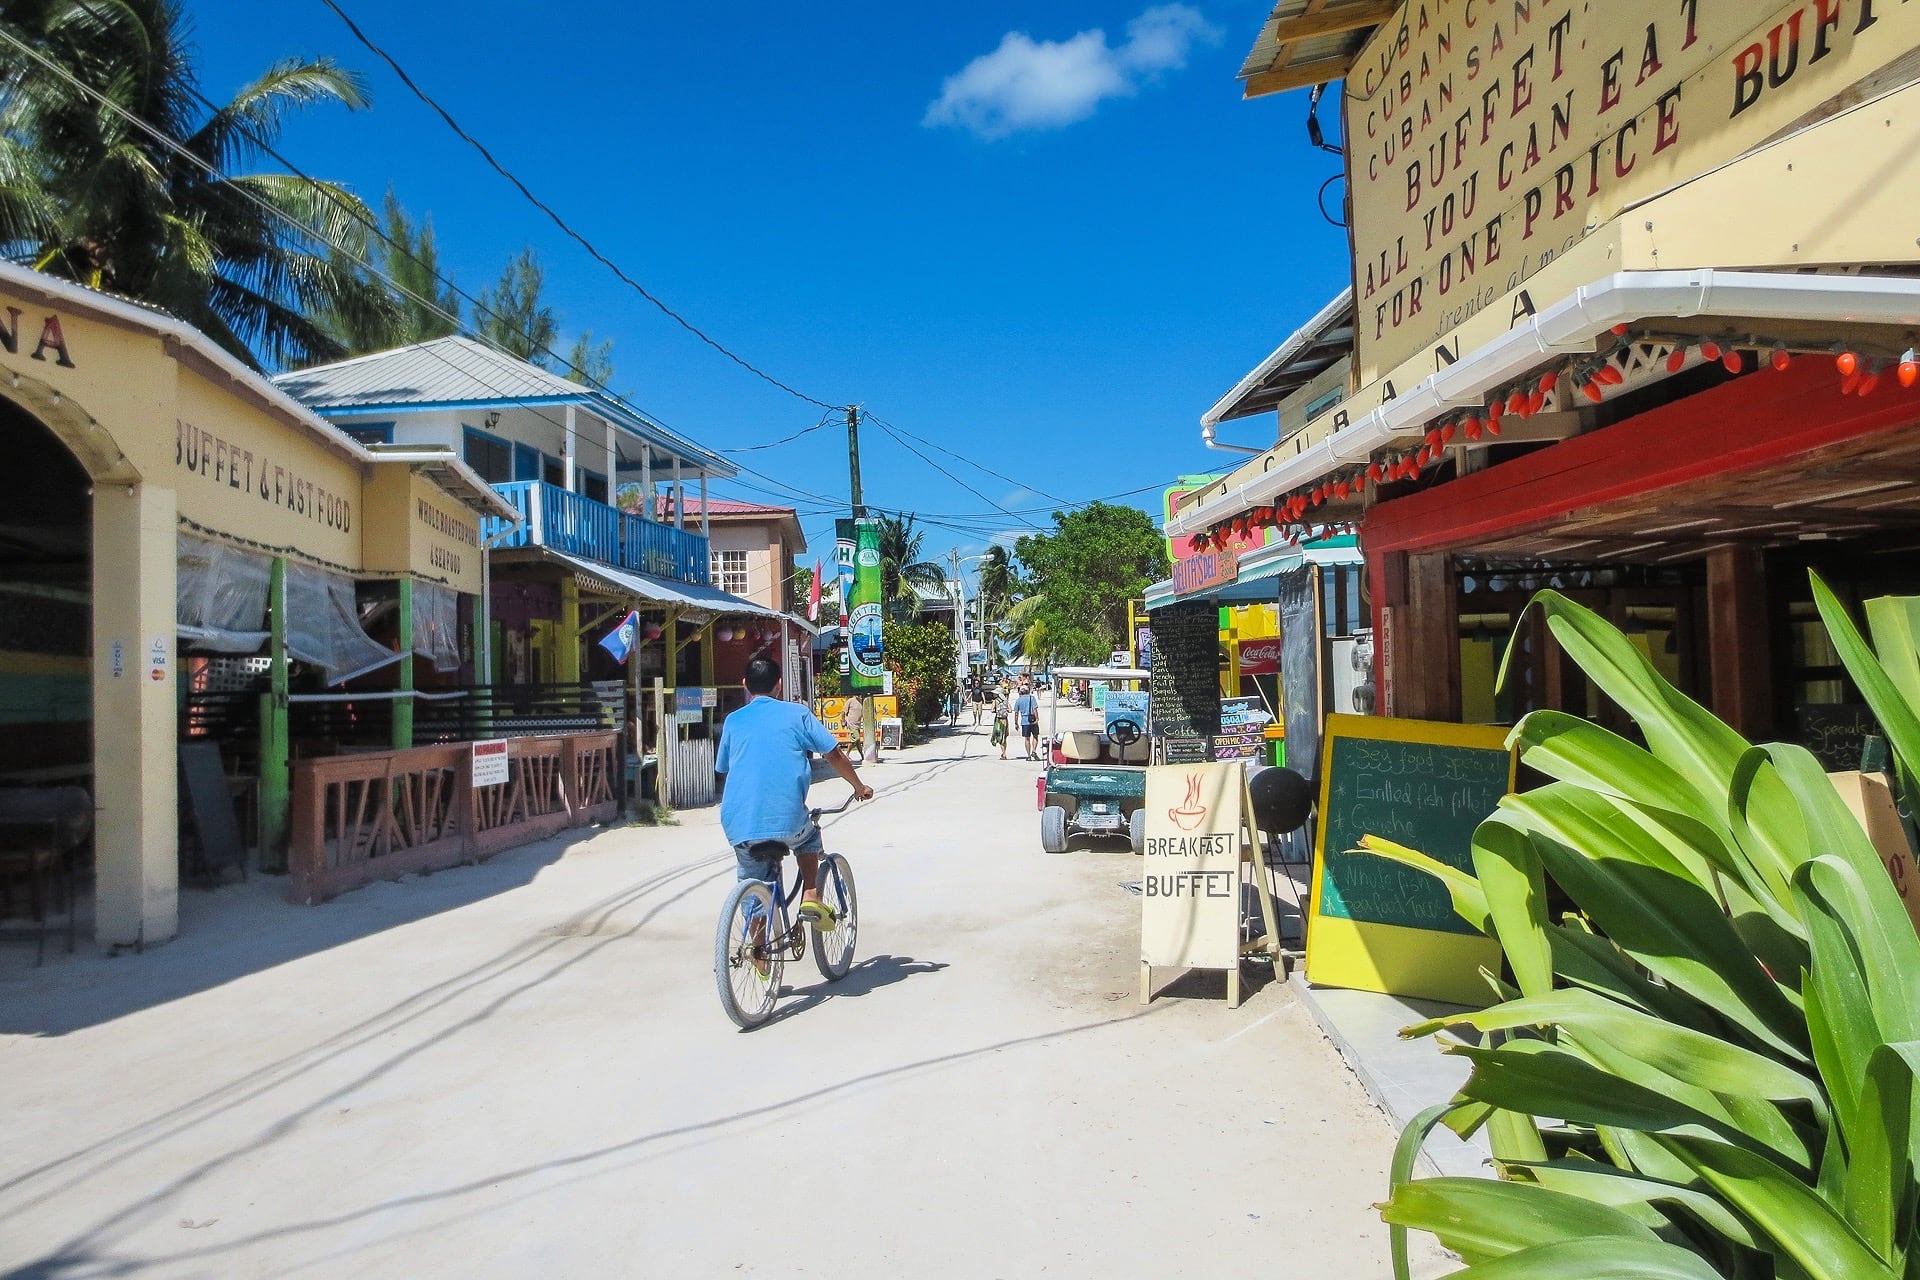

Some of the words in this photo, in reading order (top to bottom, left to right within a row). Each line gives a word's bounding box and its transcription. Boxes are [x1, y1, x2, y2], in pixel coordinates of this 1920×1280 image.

[1367, 22, 1451, 139] CUBAN
[1369, 72, 1453, 182] CUBAN
[1466, 0, 1553, 81] SAN
[1364, 235, 1408, 300] ALL
[1423, 170, 1479, 251] YOU
[1497, 88, 1575, 192] CAN
[1596, 0, 1699, 116] EAT
[1375, 276, 1423, 341] FOR
[1439, 213, 1502, 296] ONE
[1522, 80, 1682, 241] PRICE
[1506, 255, 1529, 293] al
[259, 457, 270, 501] &
[274, 465, 314, 519] FAST
[317, 487, 351, 534] FOOD
[152, 656, 166, 665] VISA
[1417, 782, 1444, 810] fish
[1146, 832, 1235, 858] BREAKFAST
[1146, 870, 1235, 898] BUFFET
